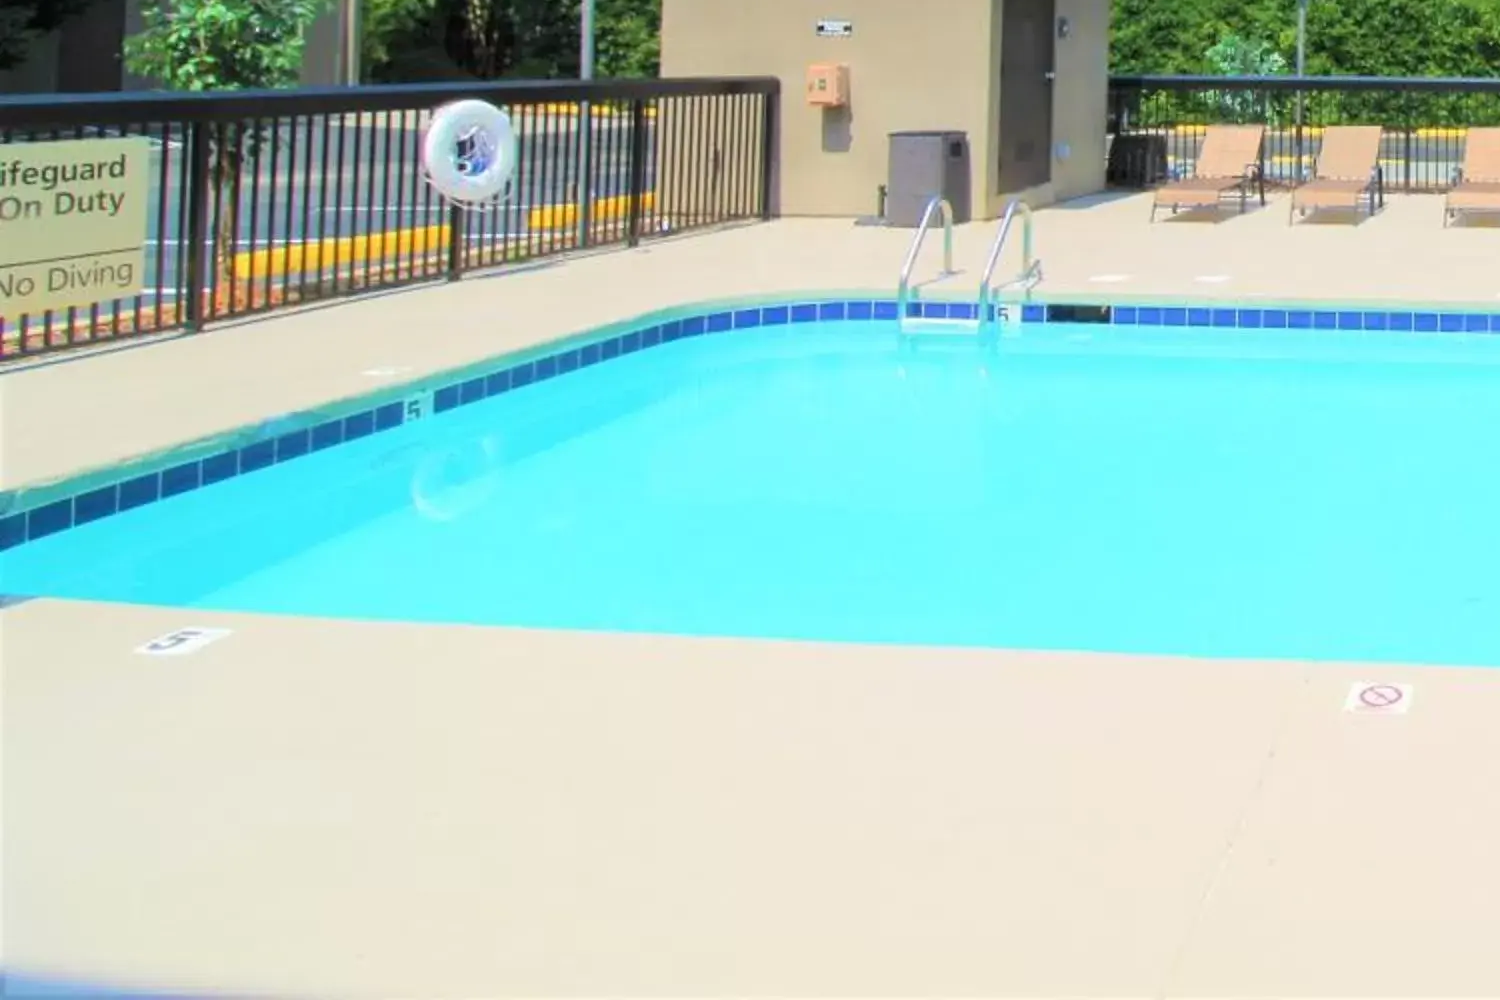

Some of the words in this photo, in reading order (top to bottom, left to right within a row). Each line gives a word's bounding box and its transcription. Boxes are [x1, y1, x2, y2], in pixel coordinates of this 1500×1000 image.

[0, 154, 126, 190] ifeguard
[0, 197, 42, 221] On
[54, 190, 125, 216] Duty
[0, 273, 35, 298] No
[48, 261, 133, 292] Diving
[407, 399, 421, 421] 5
[147, 630, 204, 651] 5
